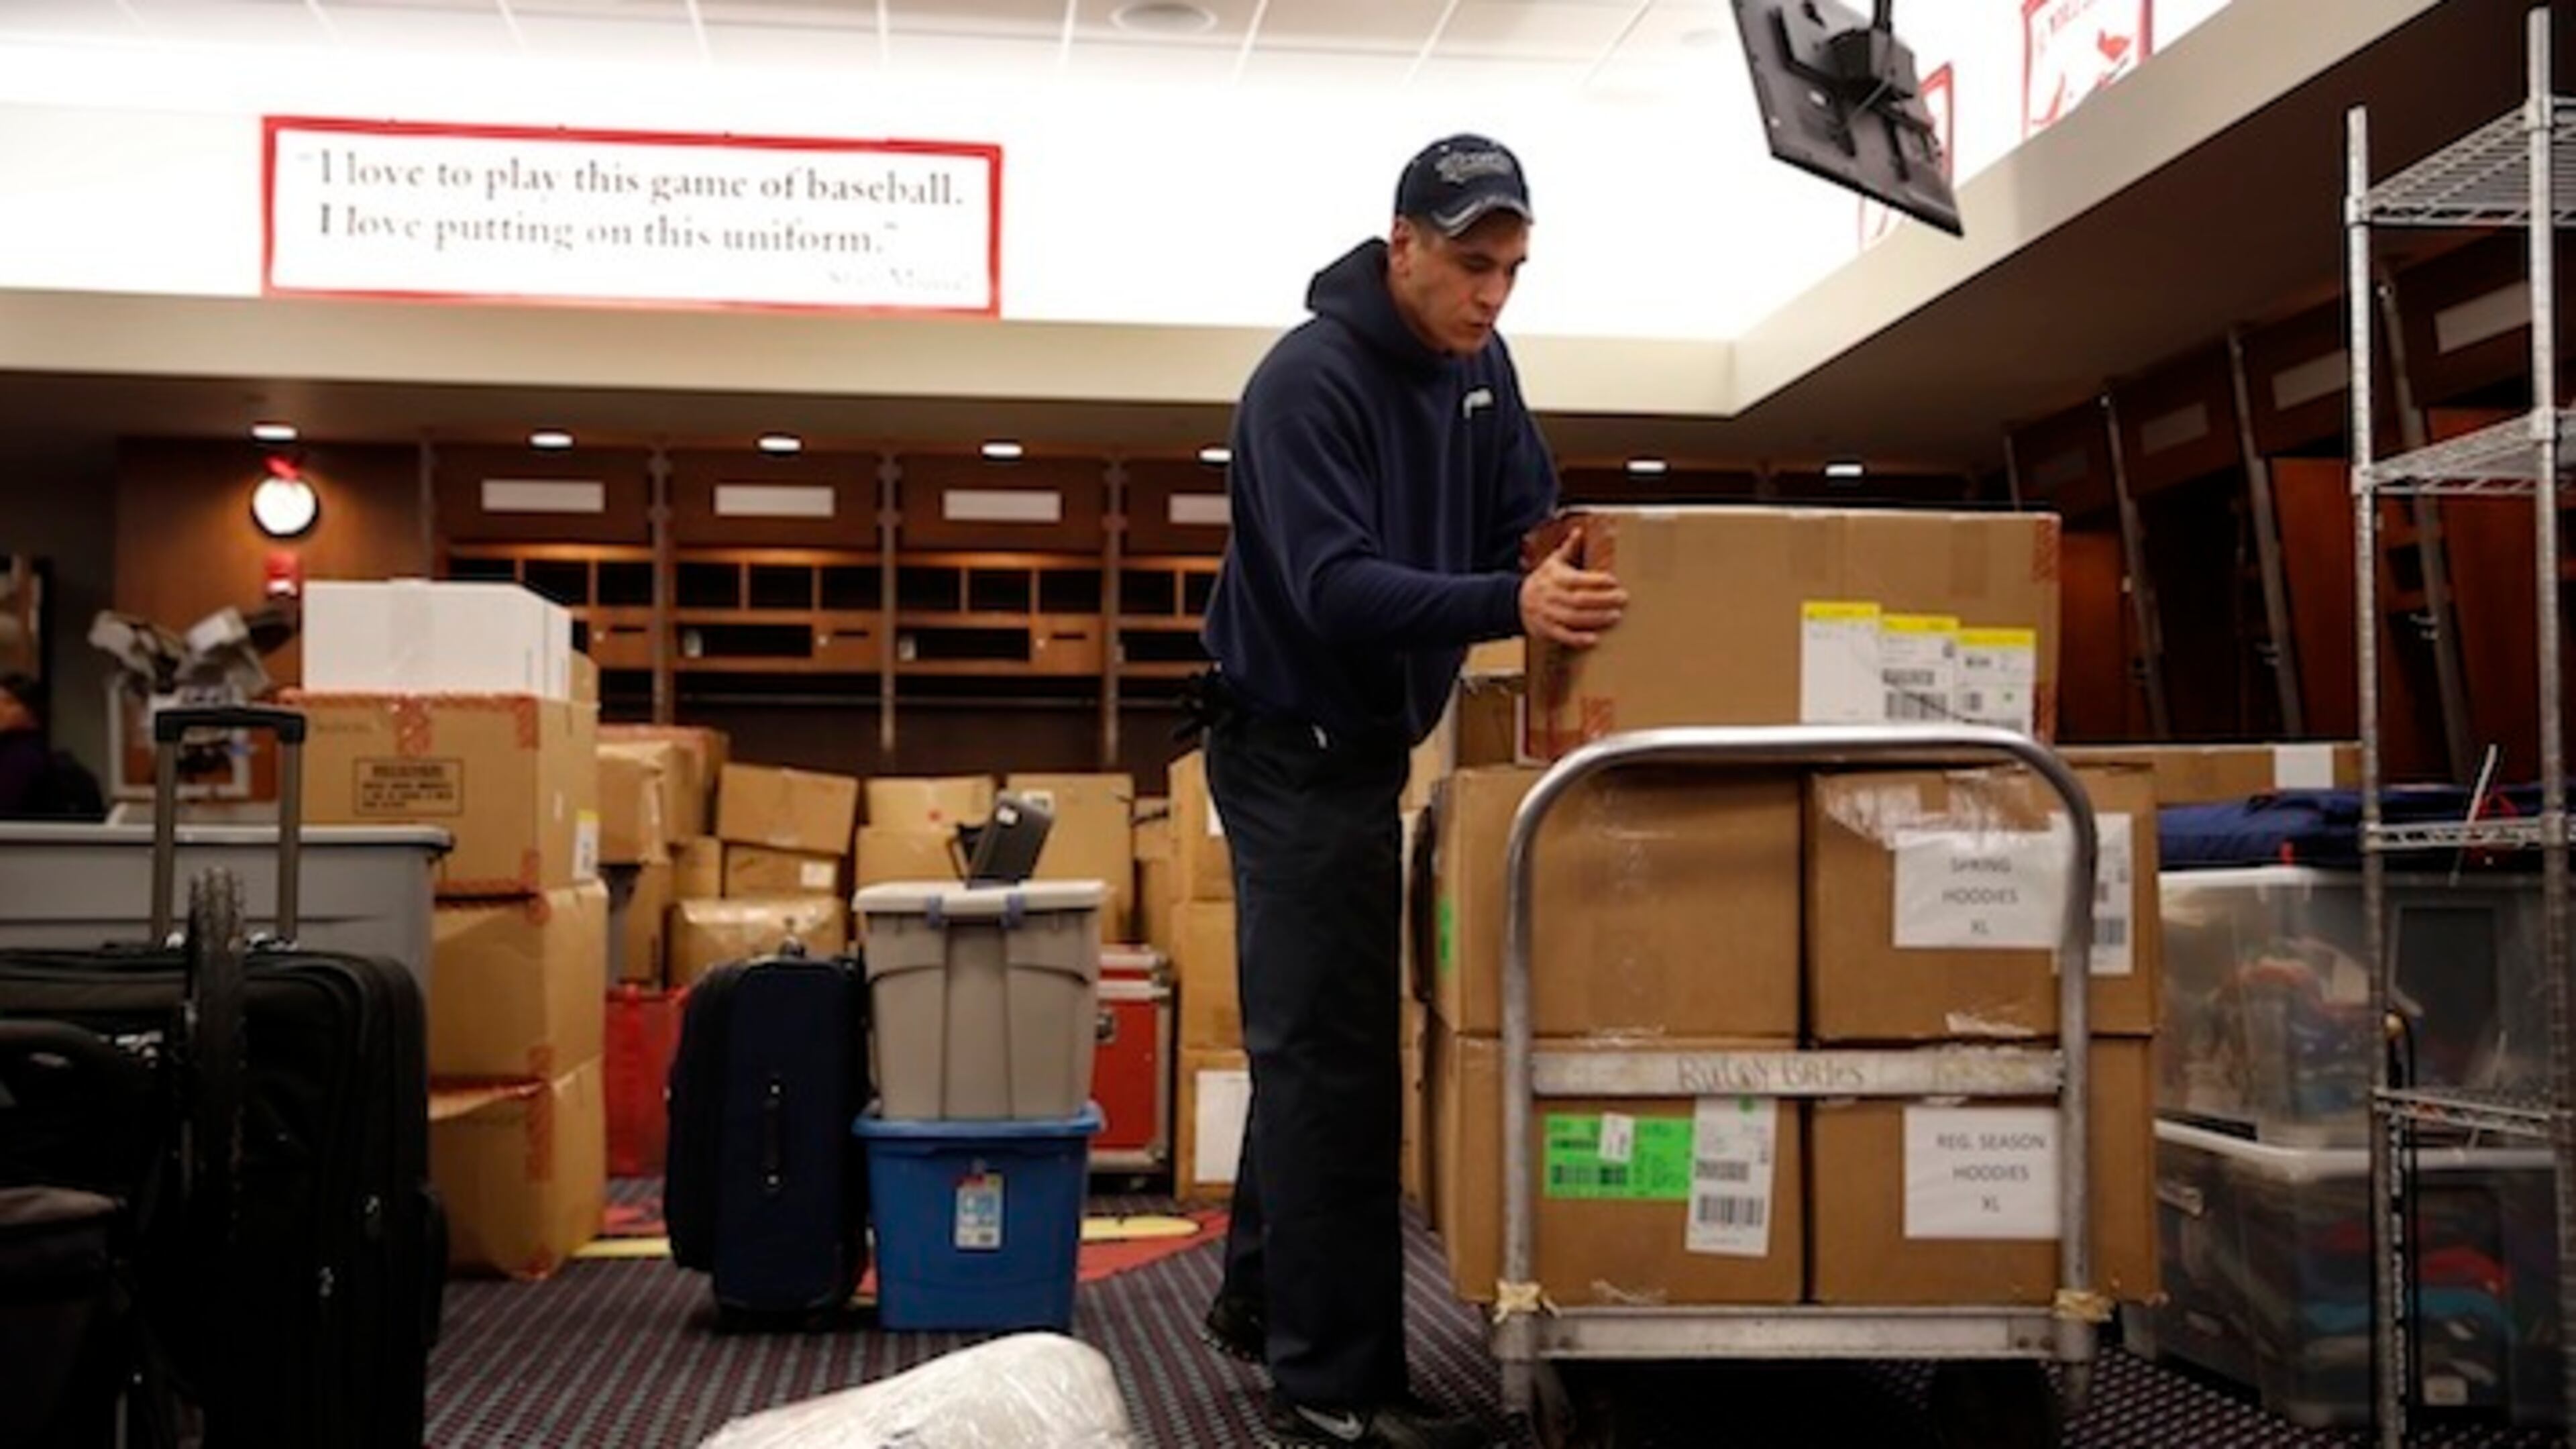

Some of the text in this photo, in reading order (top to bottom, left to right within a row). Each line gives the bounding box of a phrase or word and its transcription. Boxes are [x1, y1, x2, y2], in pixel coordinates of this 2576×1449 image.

[347, 152, 425, 186] love
[437, 164, 472, 186] to
[486, 157, 562, 204] play
[575, 159, 639, 193] this
[651, 174, 747, 205] game
[759, 166, 803, 199] of
[807, 168, 964, 204] baseball.
[321, 202, 331, 235] I
[347, 205, 423, 237] love
[436, 210, 574, 253] putting
[586, 225, 633, 246] on
[645, 214, 711, 248] this
[1950, 857, 2012, 873] SPRING
[1942, 888, 2019, 904] HOODIES
[1970, 920, 1988, 935] XL
[1937, 1133, 2045, 1151] REG. SEASON
[1951, 1165, 2031, 1181] HOODIES
[1981, 1195, 2000, 1213] XL
